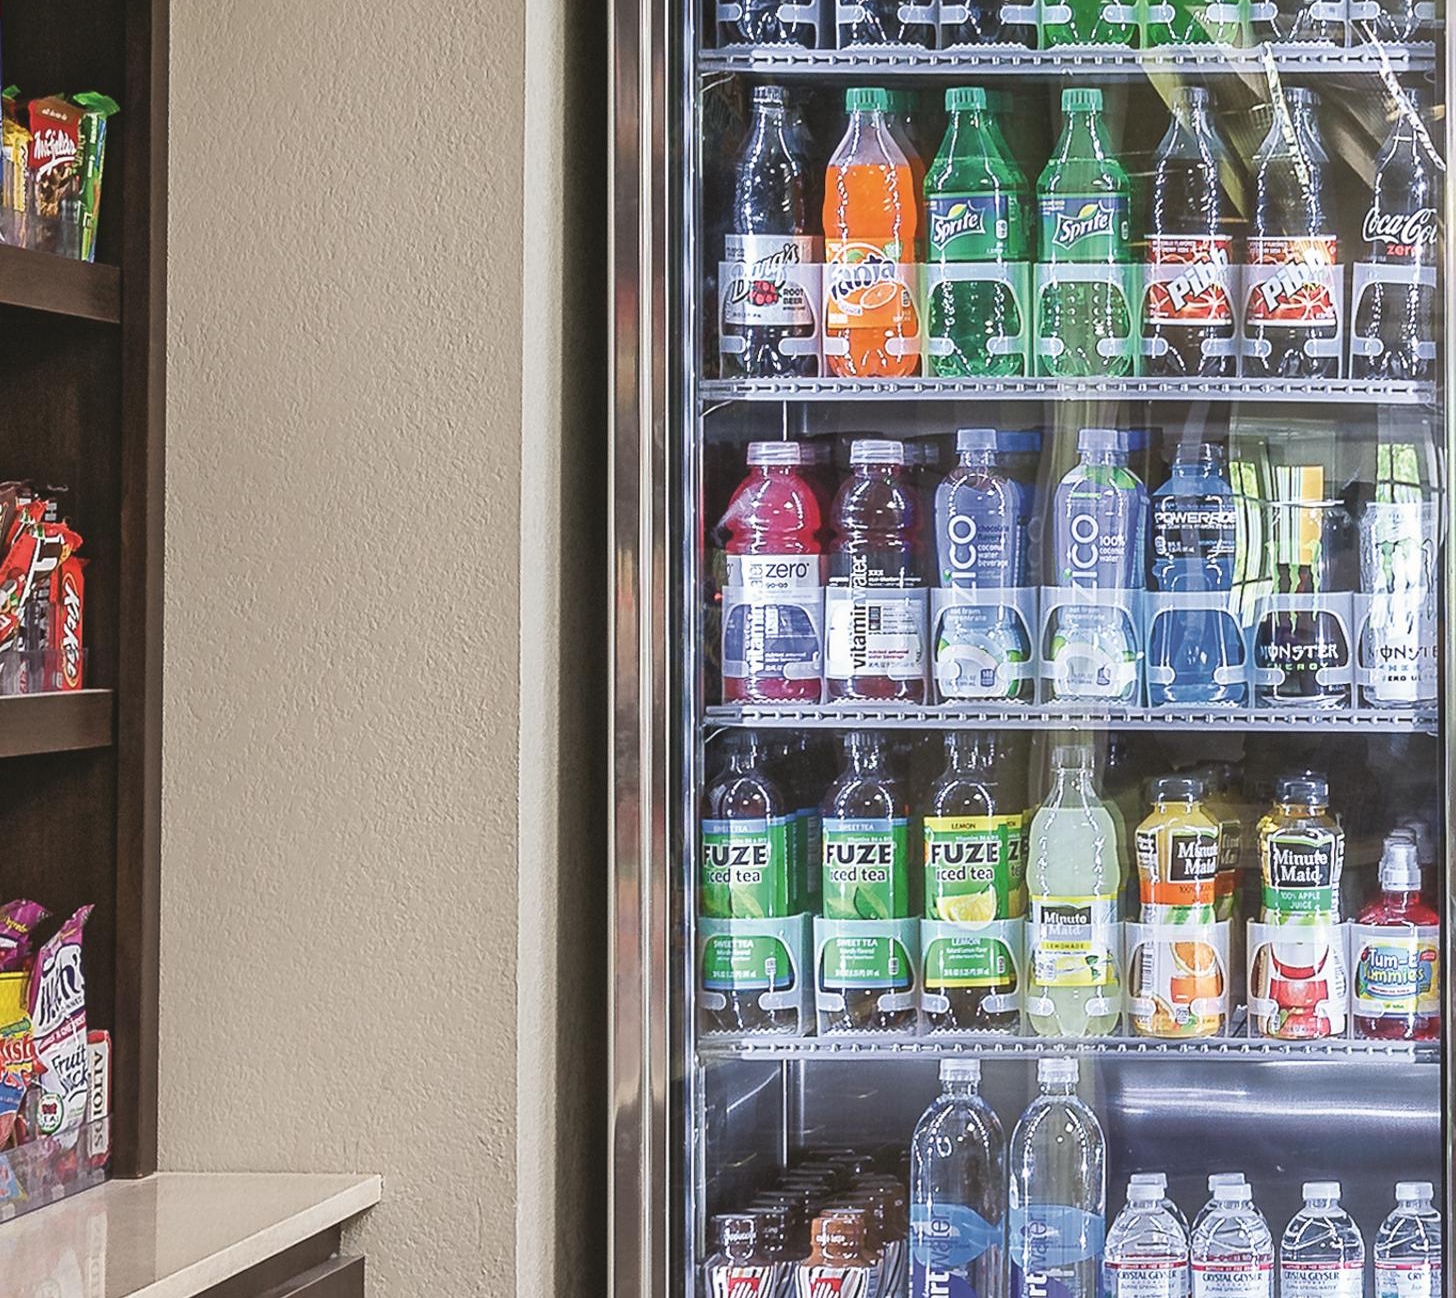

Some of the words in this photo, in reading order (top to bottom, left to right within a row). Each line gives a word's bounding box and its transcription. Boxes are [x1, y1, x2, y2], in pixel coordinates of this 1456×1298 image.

[933, 215, 980, 243] Sprite
[1059, 213, 1109, 243] Sprite
[1099, 535, 1125, 546] 100%
[765, 562, 806, 579] zero
[703, 844, 766, 866] FUZE
[826, 843, 892, 866] FUZE
[930, 843, 998, 866] FUZE
[1274, 850, 1327, 866] Minute
[1184, 859, 1216, 874] Maid
[1280, 865, 1322, 882] Maid
[707, 868, 732, 883] iced
[735, 871, 761, 883] tea
[830, 868, 858, 882] iced
[861, 869, 886, 882] tea
[936, 868, 967, 882] iced
[970, 869, 994, 881] tea
[1289, 900, 1313, 909] JUICE
[1045, 914, 1087, 925] Minute
